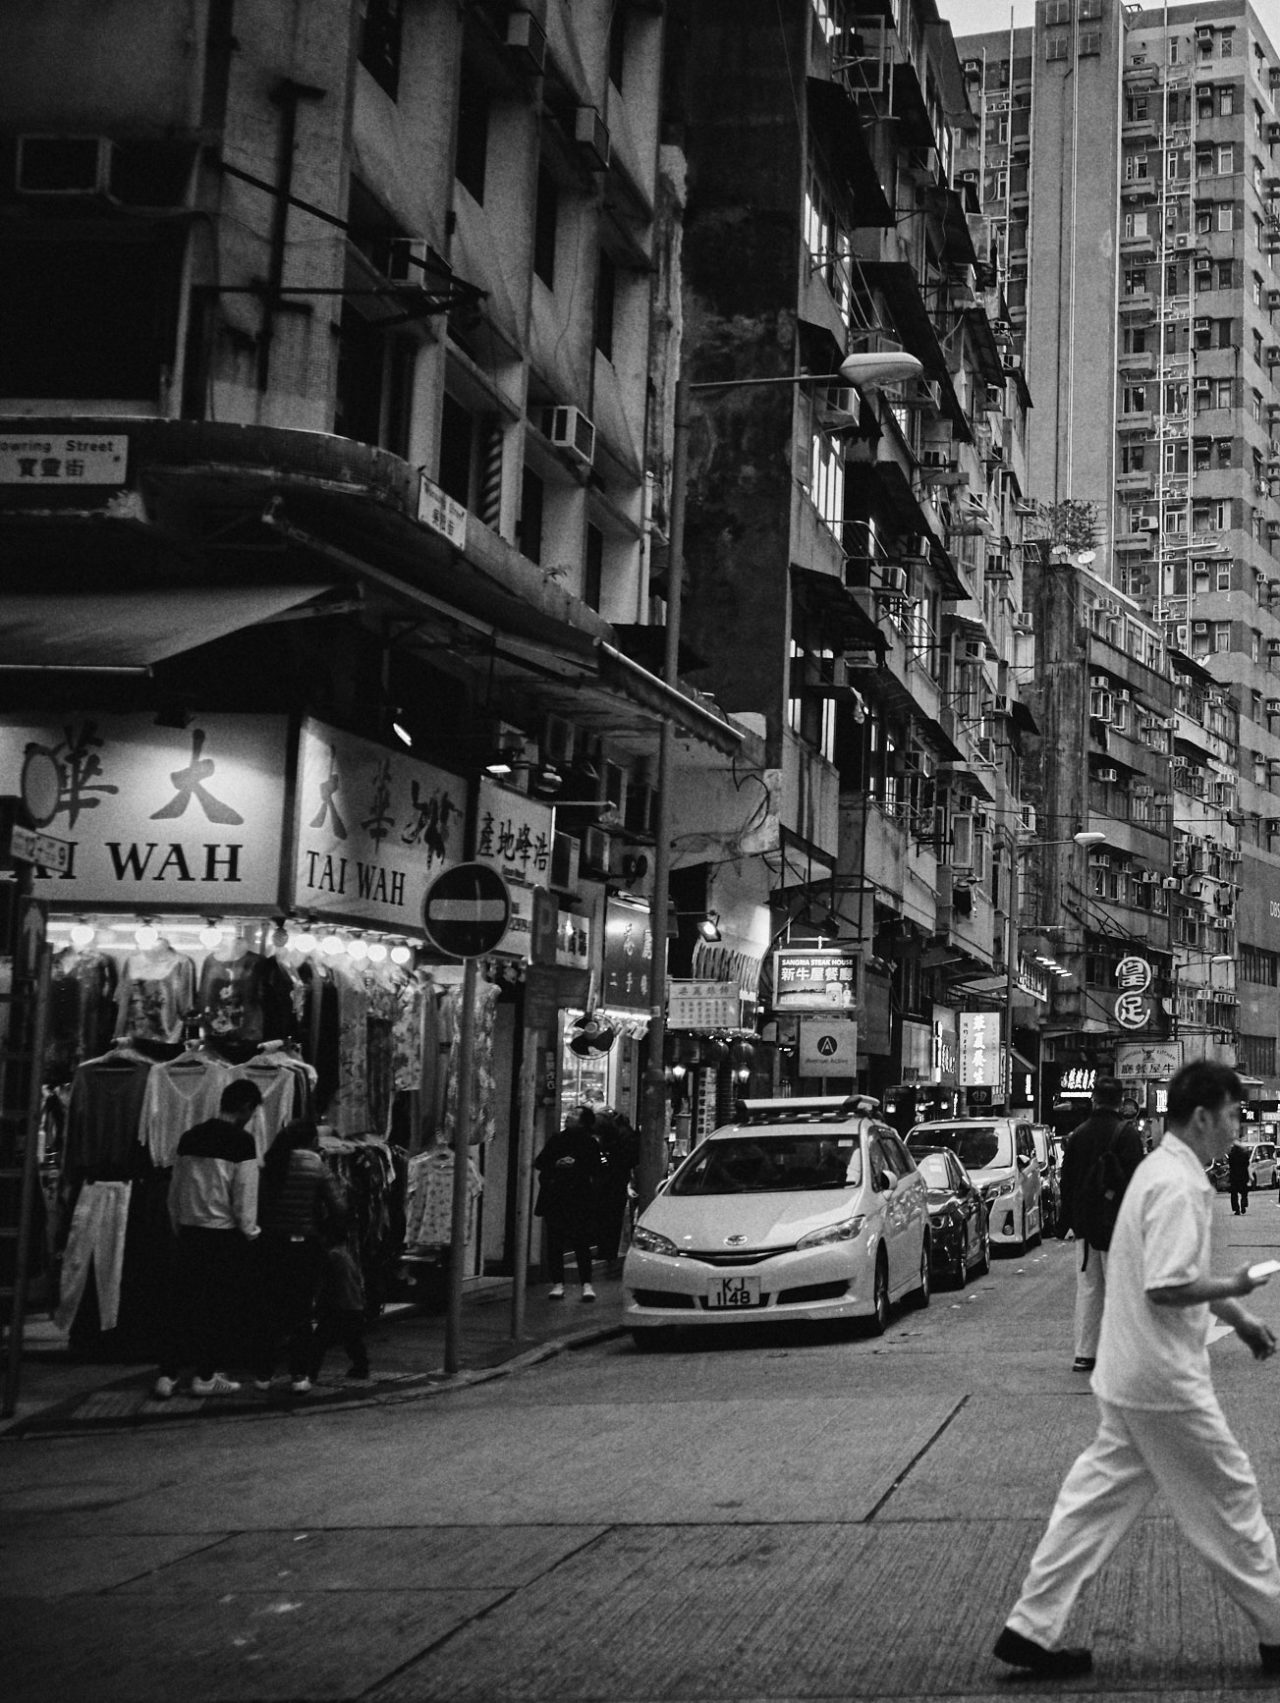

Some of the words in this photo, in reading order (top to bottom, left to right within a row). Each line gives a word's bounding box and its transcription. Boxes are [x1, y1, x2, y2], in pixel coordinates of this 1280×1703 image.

[104, 842, 244, 882] WAH
[306, 850, 348, 895] TAI
[356, 861, 406, 907] WAH
[716, 1290, 750, 1305] 1148
[722, 1278, 745, 1291] KJ
